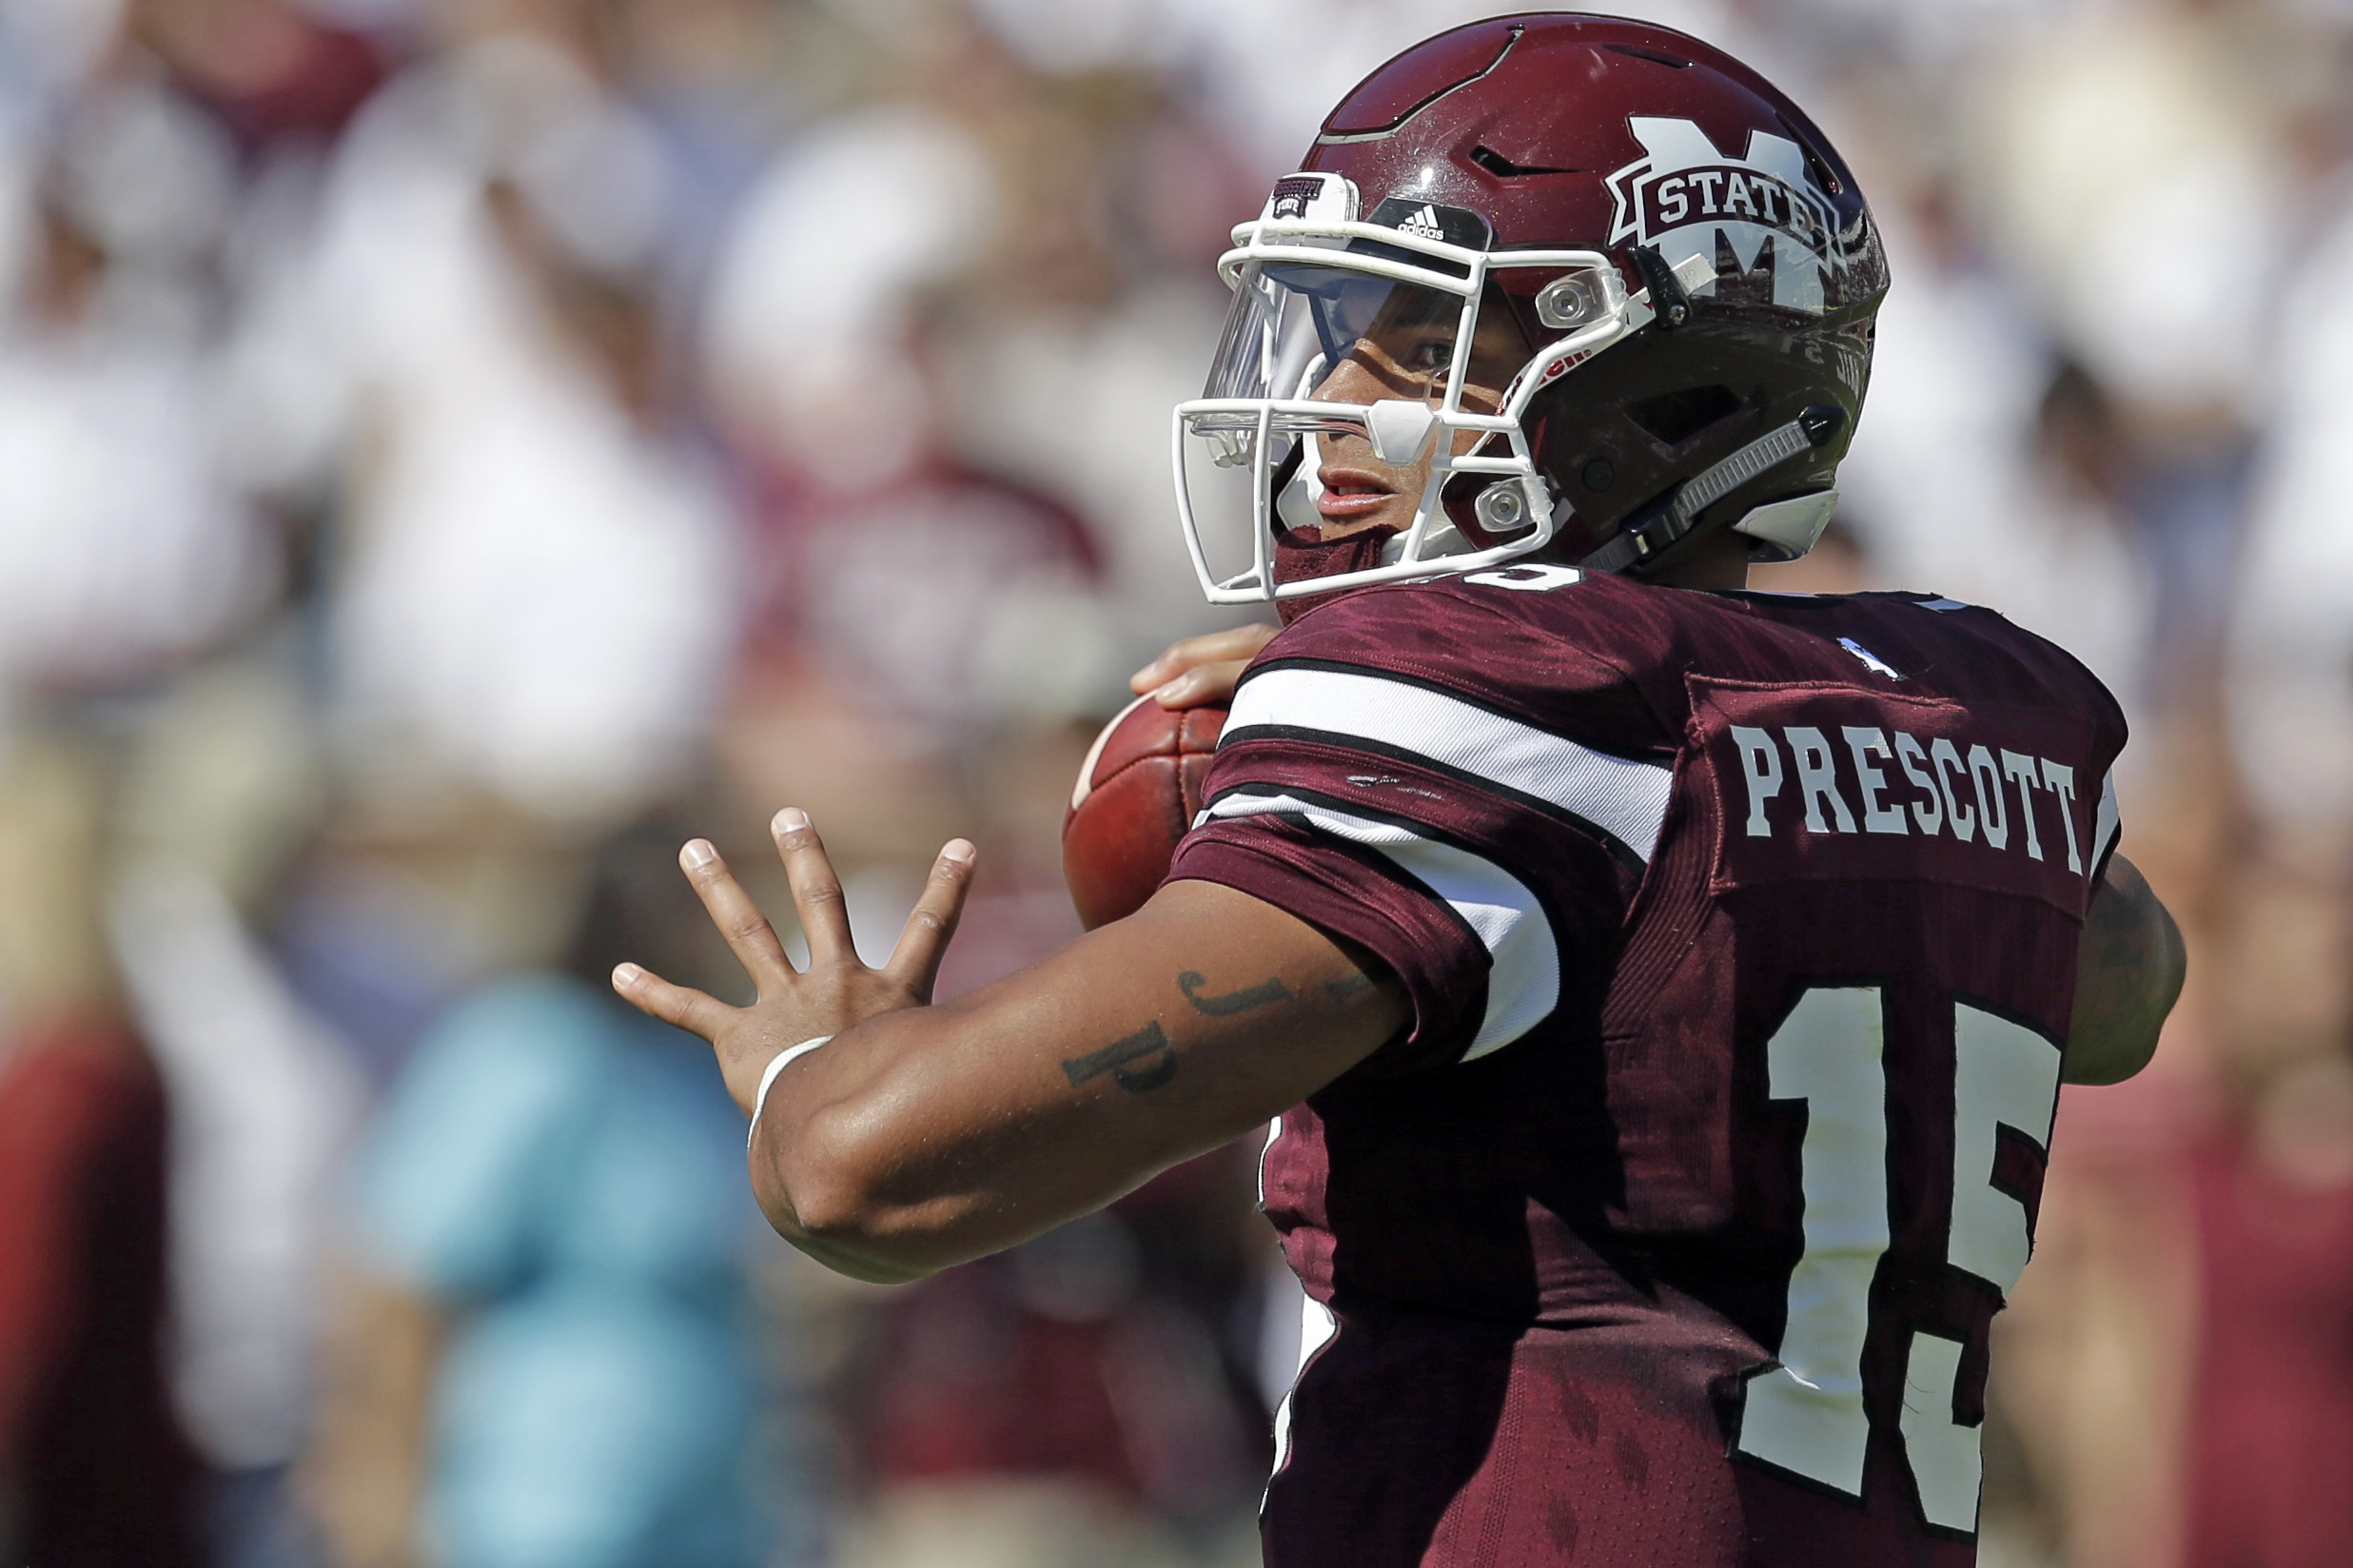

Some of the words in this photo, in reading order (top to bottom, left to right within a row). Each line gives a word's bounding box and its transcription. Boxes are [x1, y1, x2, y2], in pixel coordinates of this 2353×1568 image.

[1398, 223, 1443, 240] adidas
[1657, 171, 1814, 245] STATE
[1729, 724, 2084, 877] PRESCOTT
[1737, 986, 2062, 1533] 15
